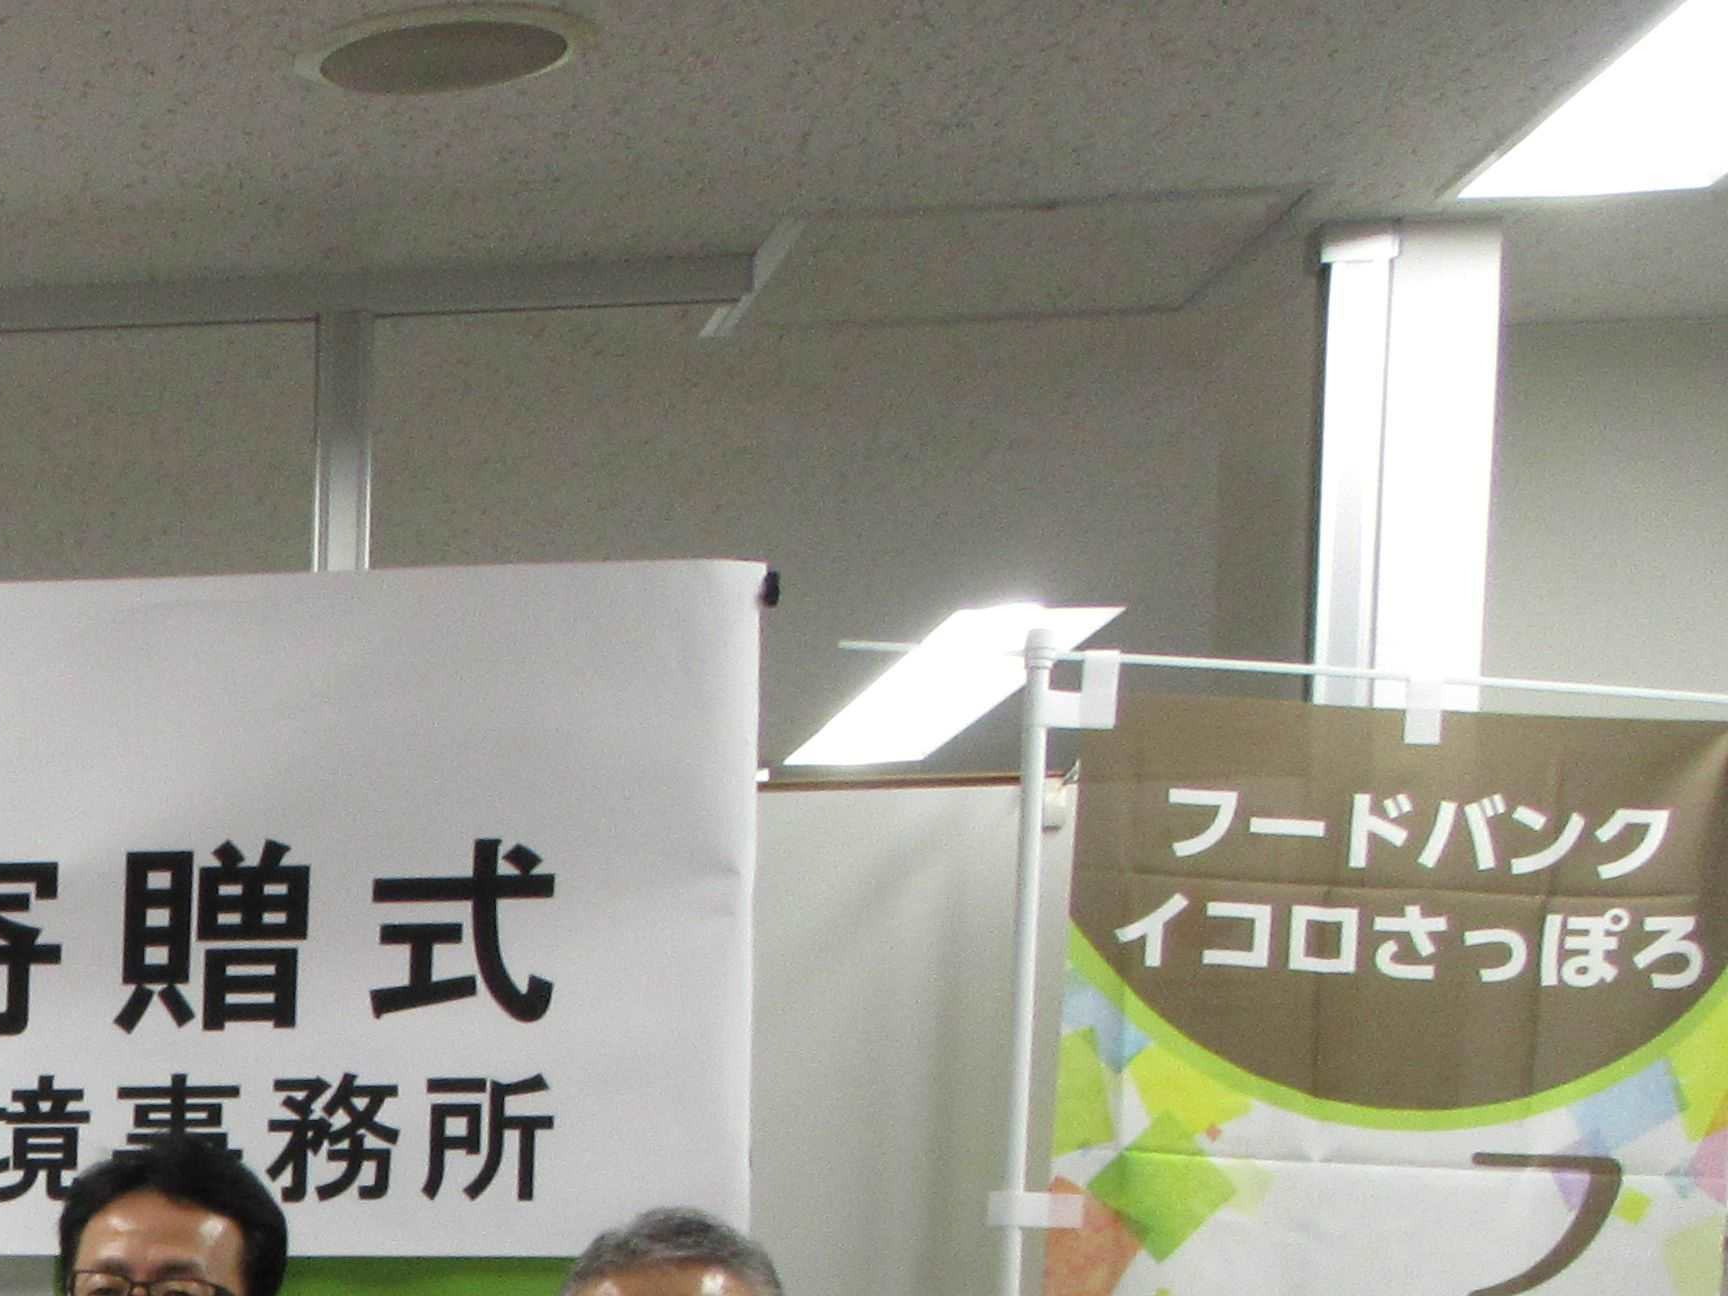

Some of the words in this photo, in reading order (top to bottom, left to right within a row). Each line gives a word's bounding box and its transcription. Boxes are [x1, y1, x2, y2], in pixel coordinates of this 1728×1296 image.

[1167, 784, 1672, 881] フードバンク
[1114, 896, 1707, 995] イコロさっぽろ
